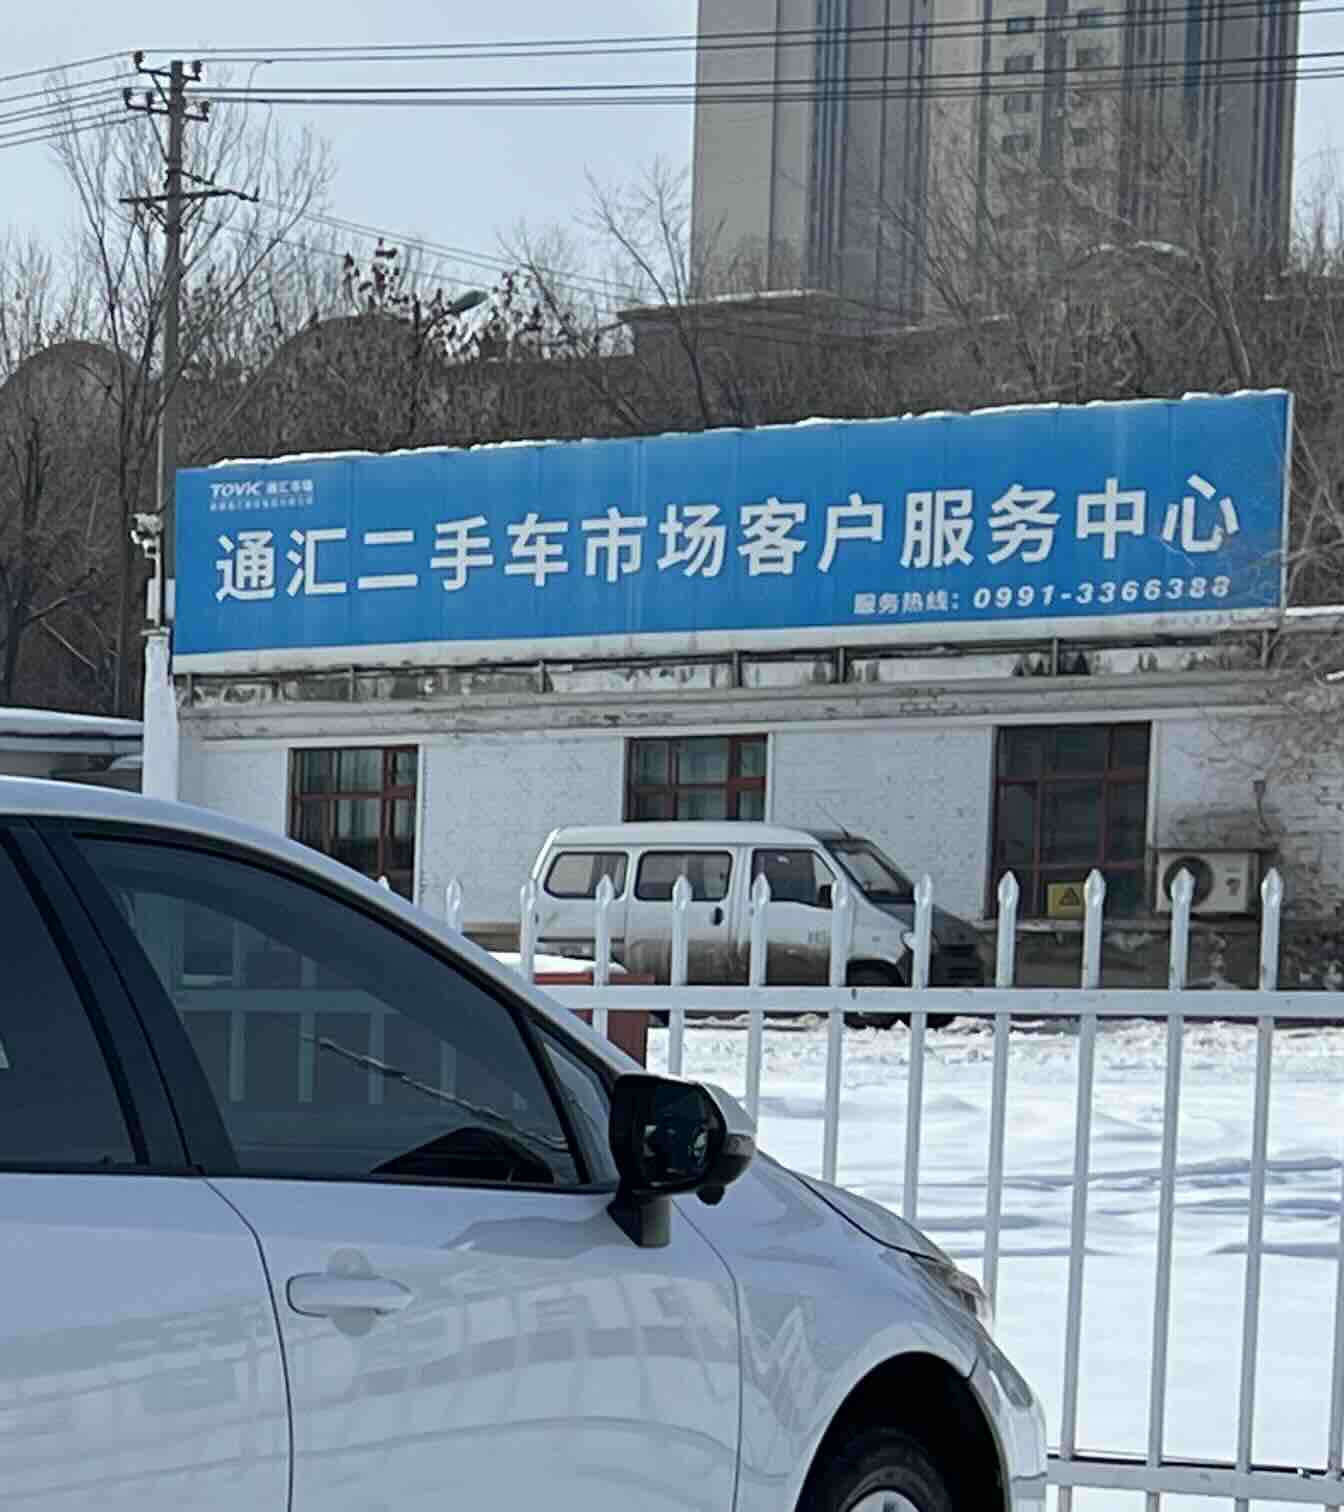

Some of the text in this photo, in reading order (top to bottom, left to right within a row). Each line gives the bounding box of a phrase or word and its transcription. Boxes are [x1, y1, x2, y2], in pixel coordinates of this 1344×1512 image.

[215, 473, 1240, 602] 通汇二手车市场客户服务中心
[972, 574, 1231, 611] 0991-3366388
